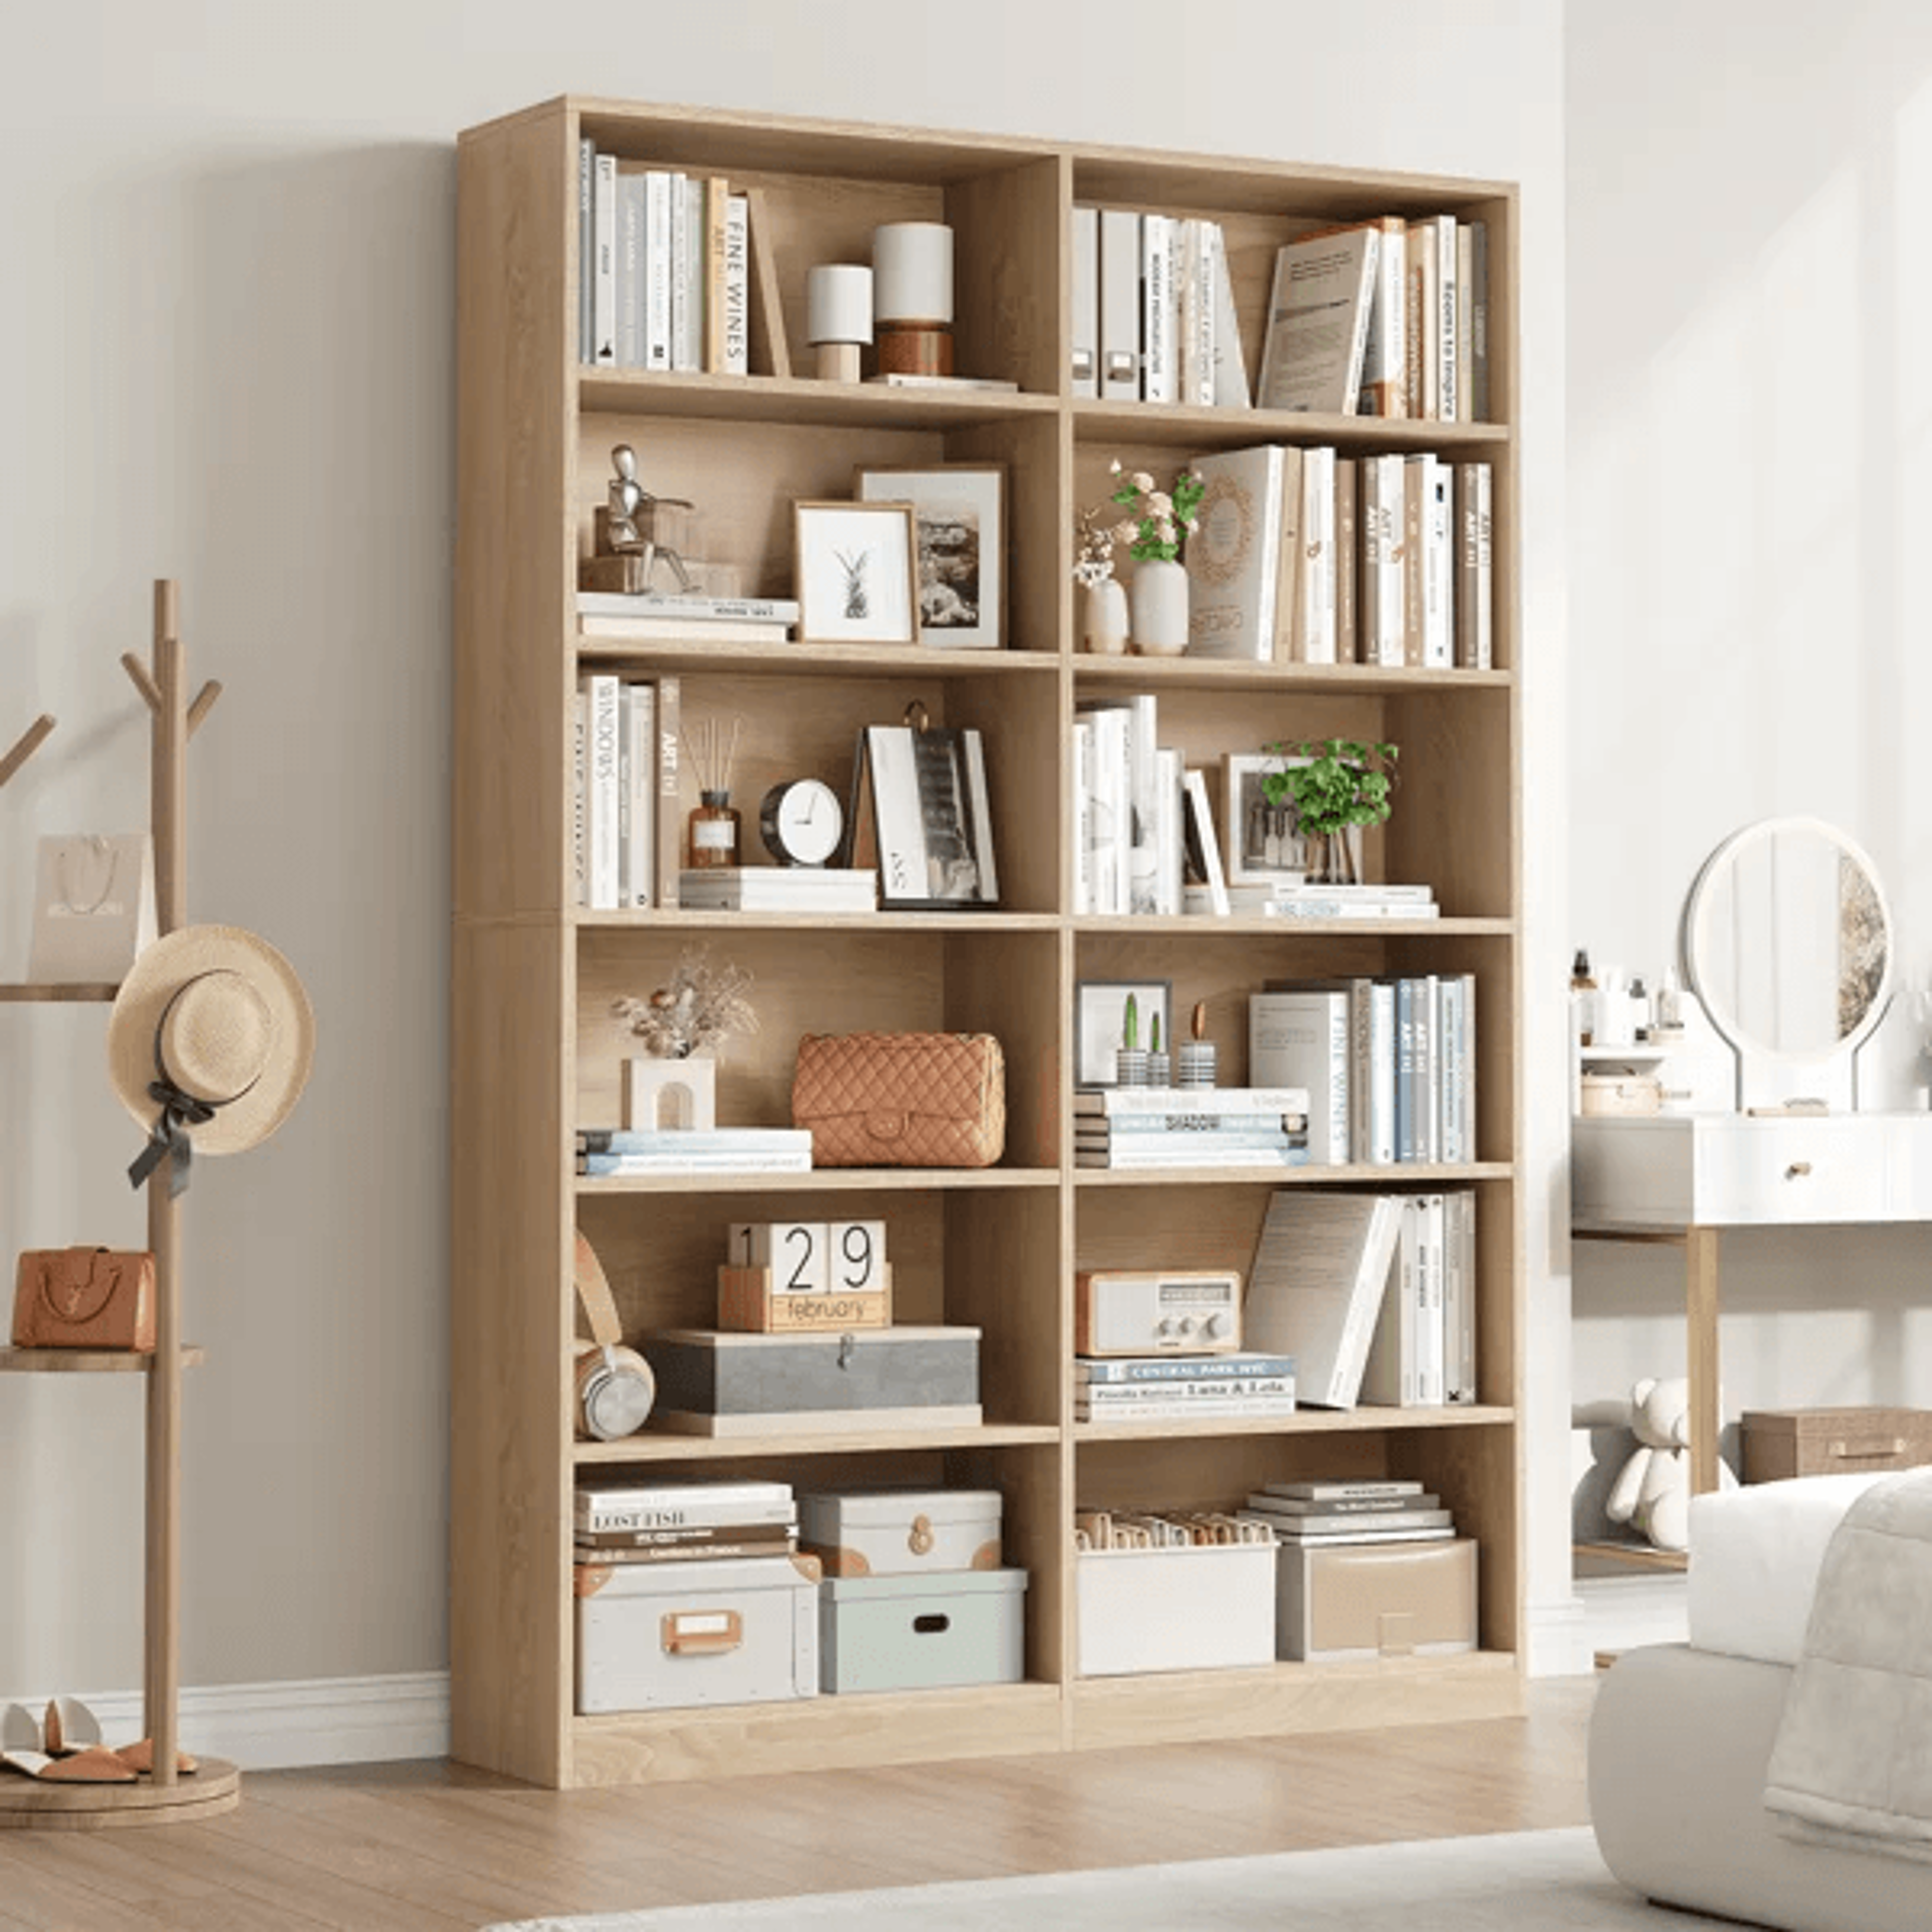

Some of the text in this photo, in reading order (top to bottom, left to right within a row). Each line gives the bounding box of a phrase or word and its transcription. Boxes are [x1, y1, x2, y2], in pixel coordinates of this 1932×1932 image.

[728, 221, 744, 359] FINE WINES
[1442, 282, 1454, 335] Rooms
[1442, 340, 1454, 357] to
[596, 681, 615, 780] WINDOWS
[661, 732, 678, 771] ART
[741, 1227, 751, 1267] 1
[785, 1226, 872, 1289] 2 9
[788, 1298, 867, 1319] february
[1132, 1366, 1195, 1378] CENTRAL
[595, 1510, 684, 1529] LOST FISH
